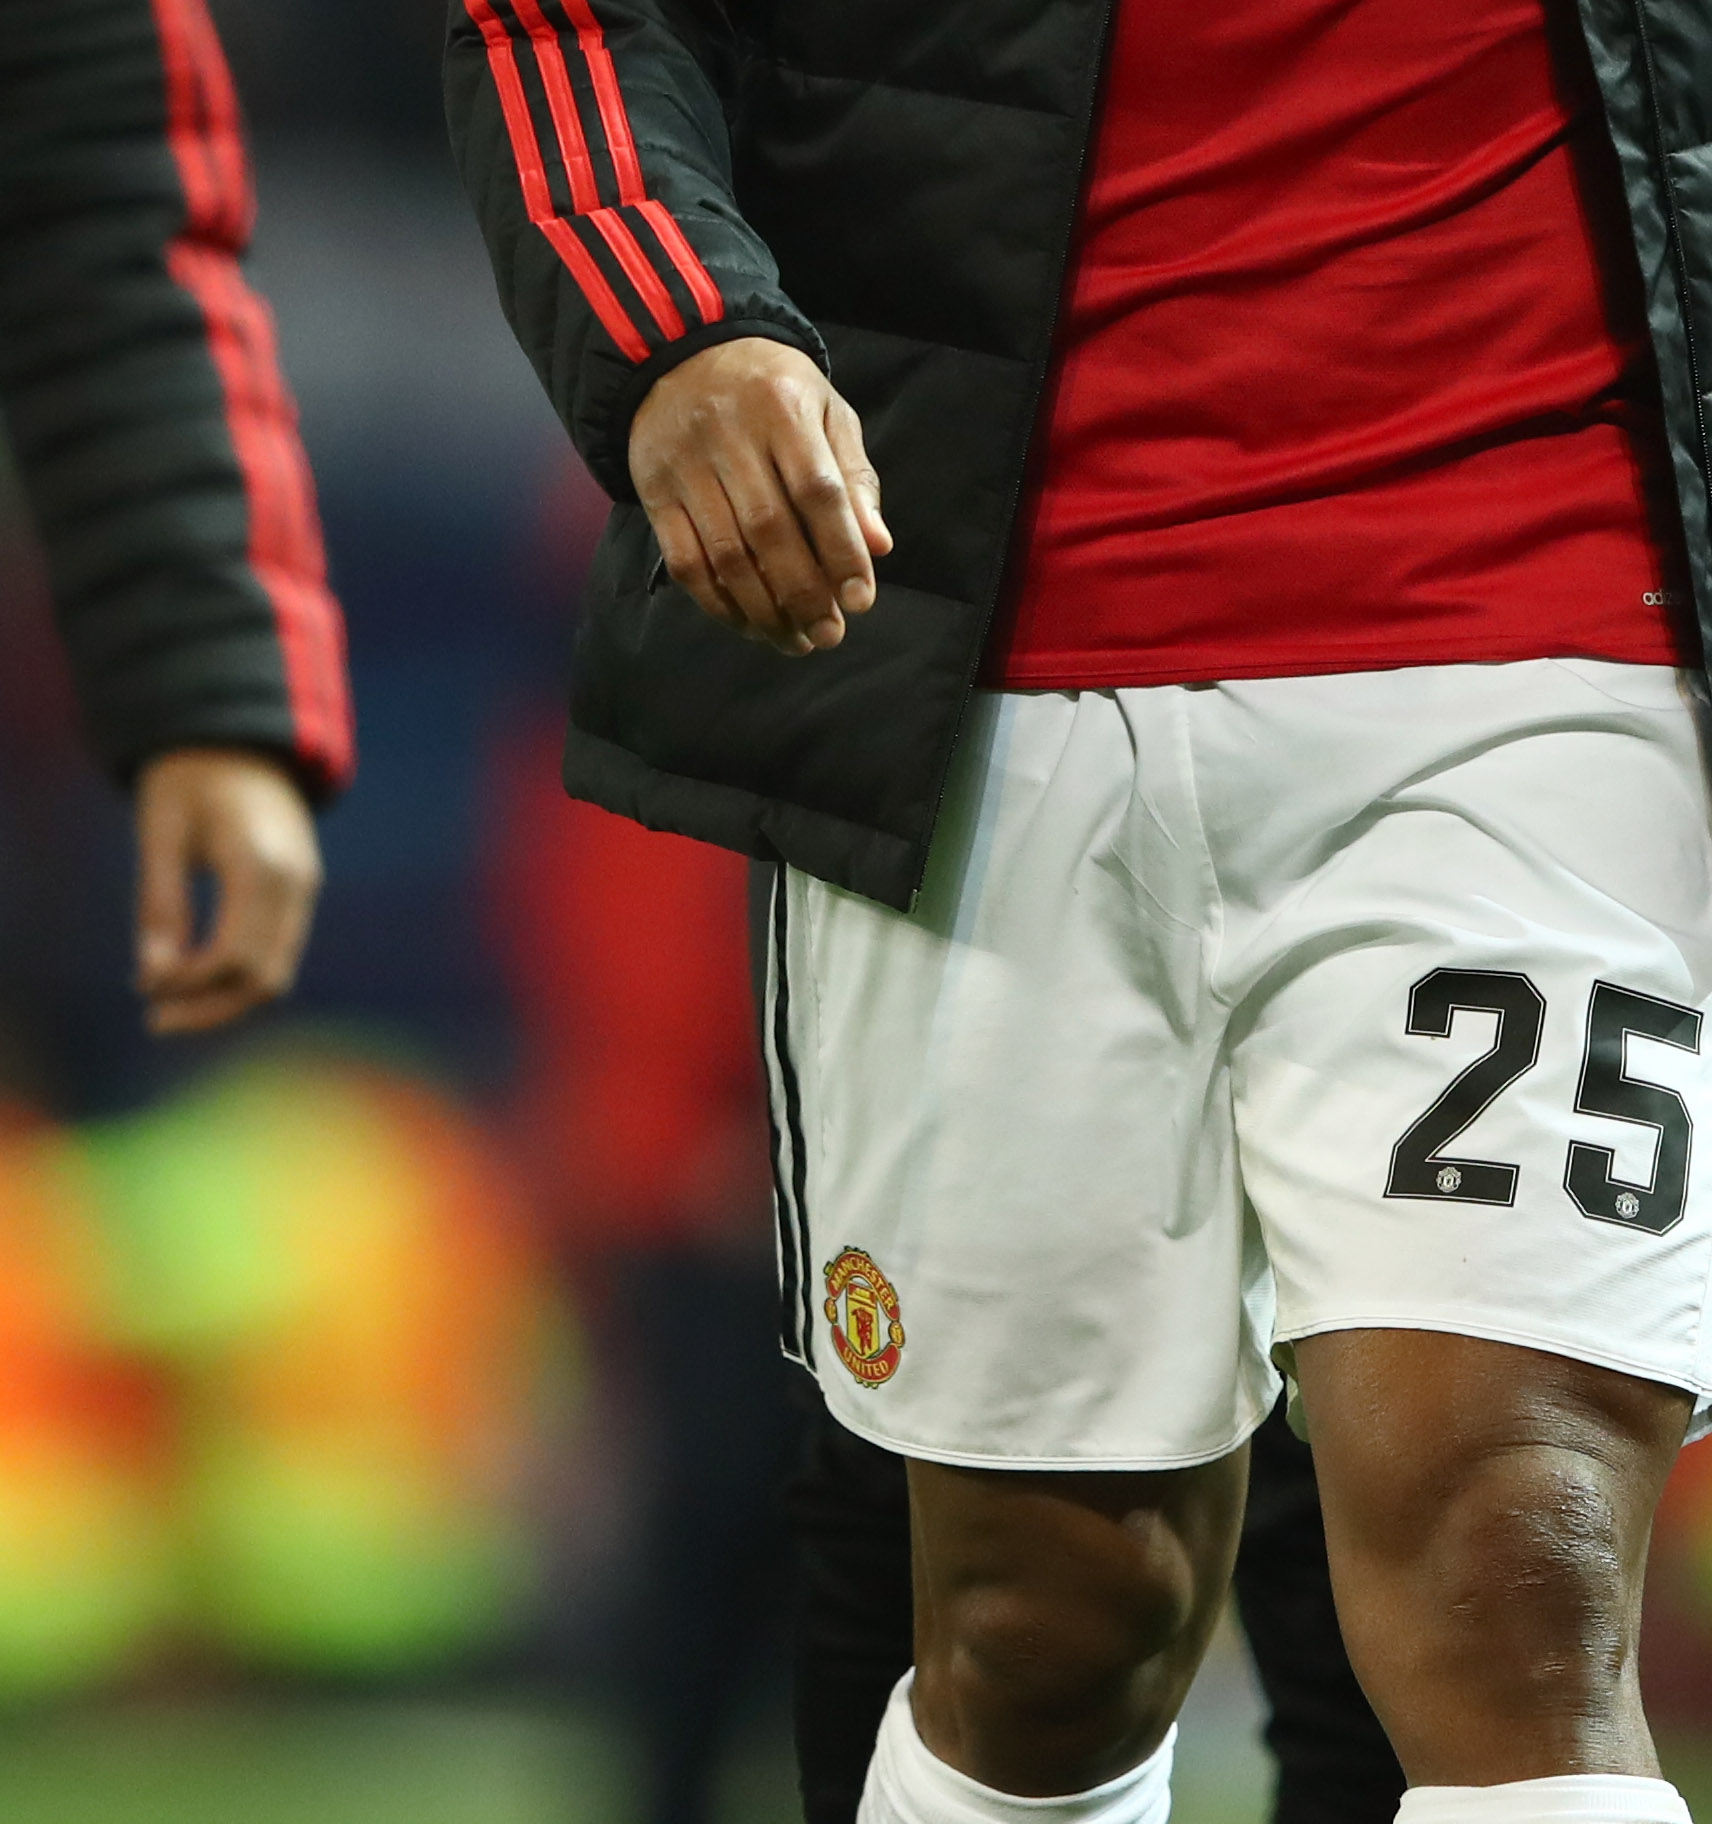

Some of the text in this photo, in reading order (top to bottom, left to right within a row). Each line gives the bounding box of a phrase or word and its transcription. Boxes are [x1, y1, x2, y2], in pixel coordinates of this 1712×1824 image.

[1383, 967, 1704, 1237] 25
[831, 1257, 895, 1311] MANCHESTER
[843, 1347, 888, 1376] UNITED
